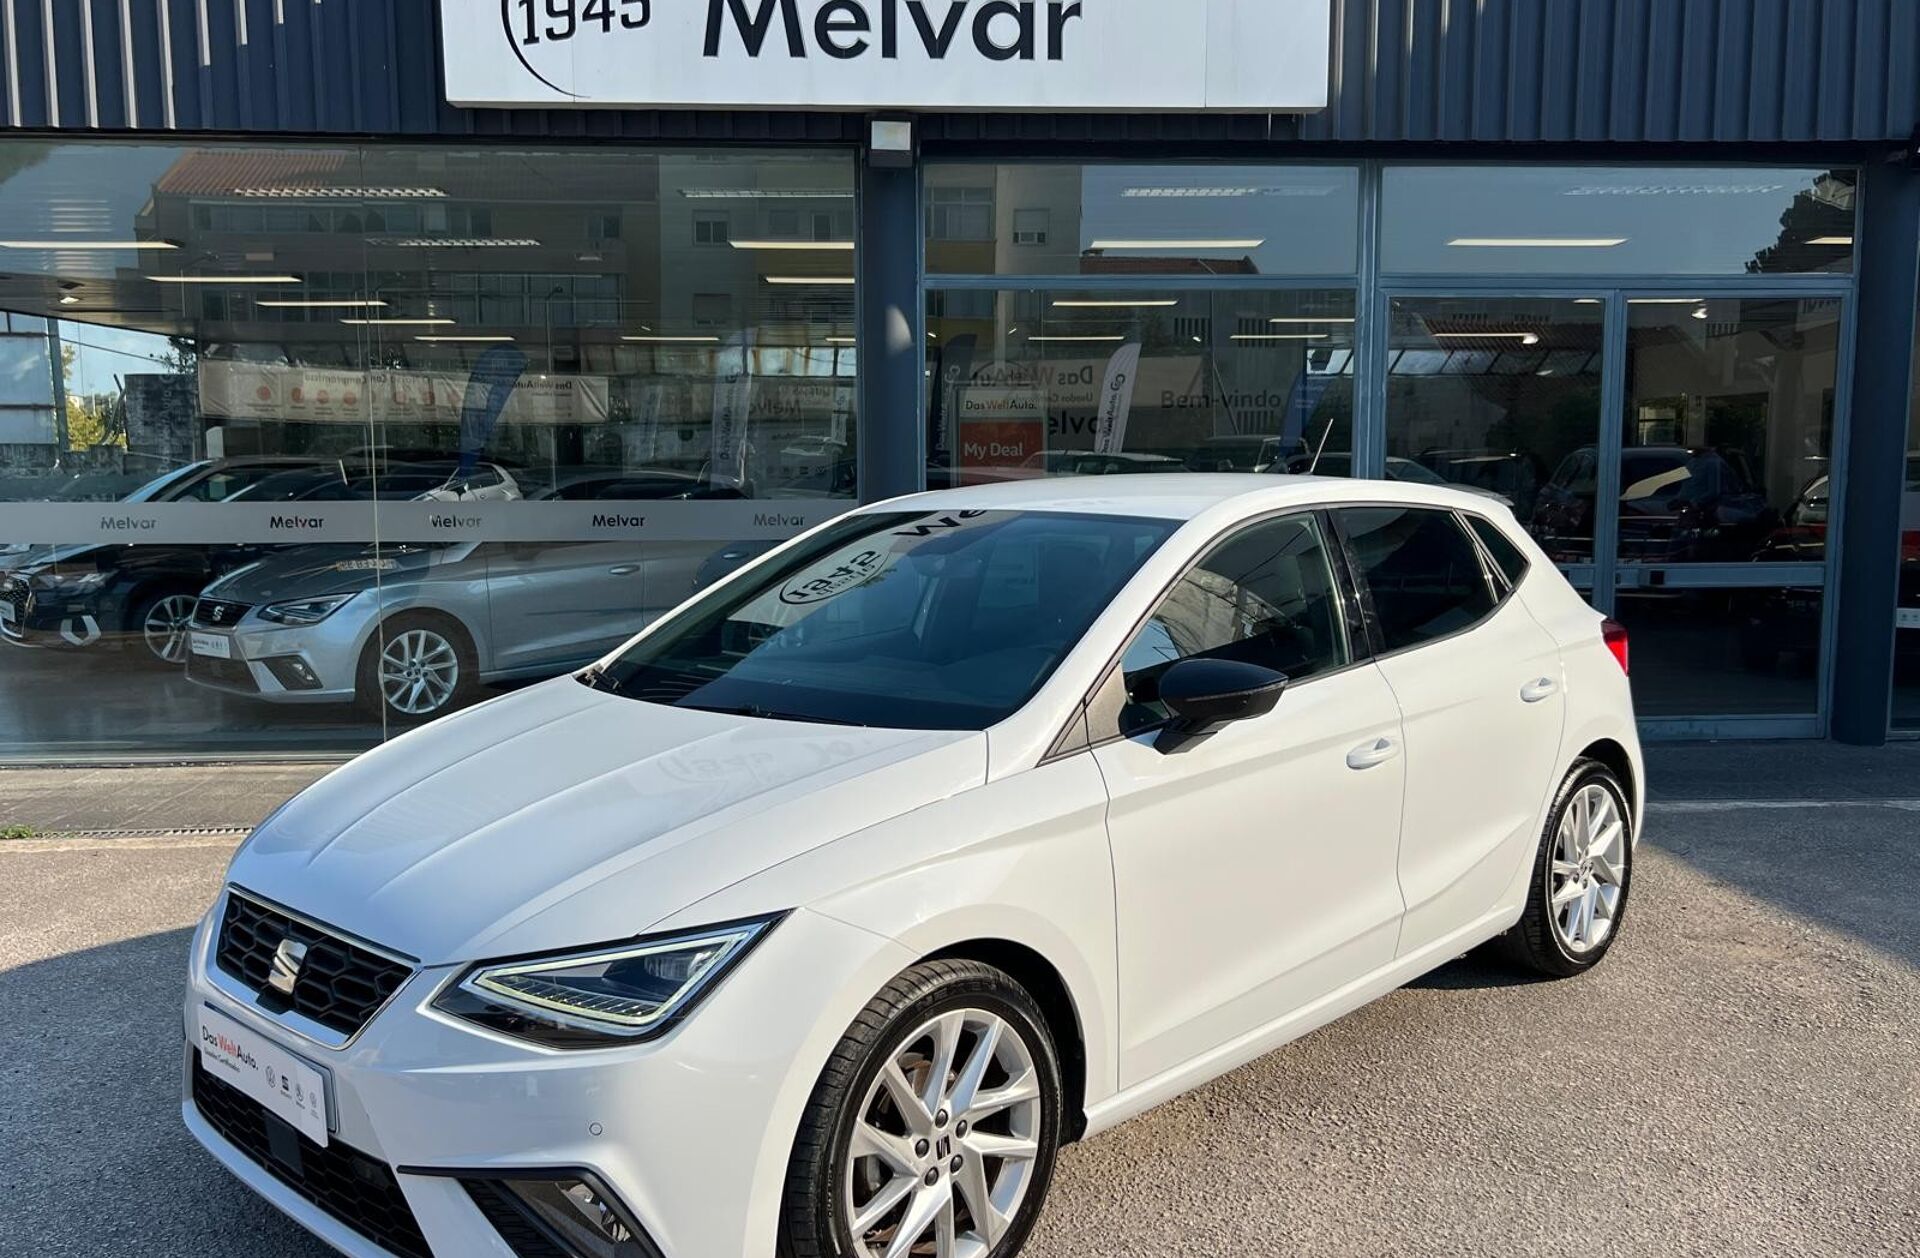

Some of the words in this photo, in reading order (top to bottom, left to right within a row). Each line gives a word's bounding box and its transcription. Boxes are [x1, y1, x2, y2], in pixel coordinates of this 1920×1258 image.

[518, 0, 651, 46] 1945
[702, 0, 1083, 61] Melvar
[1161, 389, 1281, 409] Bem-vindo
[964, 443, 987, 460] My
[990, 441, 1023, 457] Deal
[100, 515, 157, 530] Melvar
[270, 515, 325, 529] Melvar
[430, 515, 482, 529] Melvar
[592, 514, 645, 527] Melvar
[754, 513, 805, 527] Melvar
